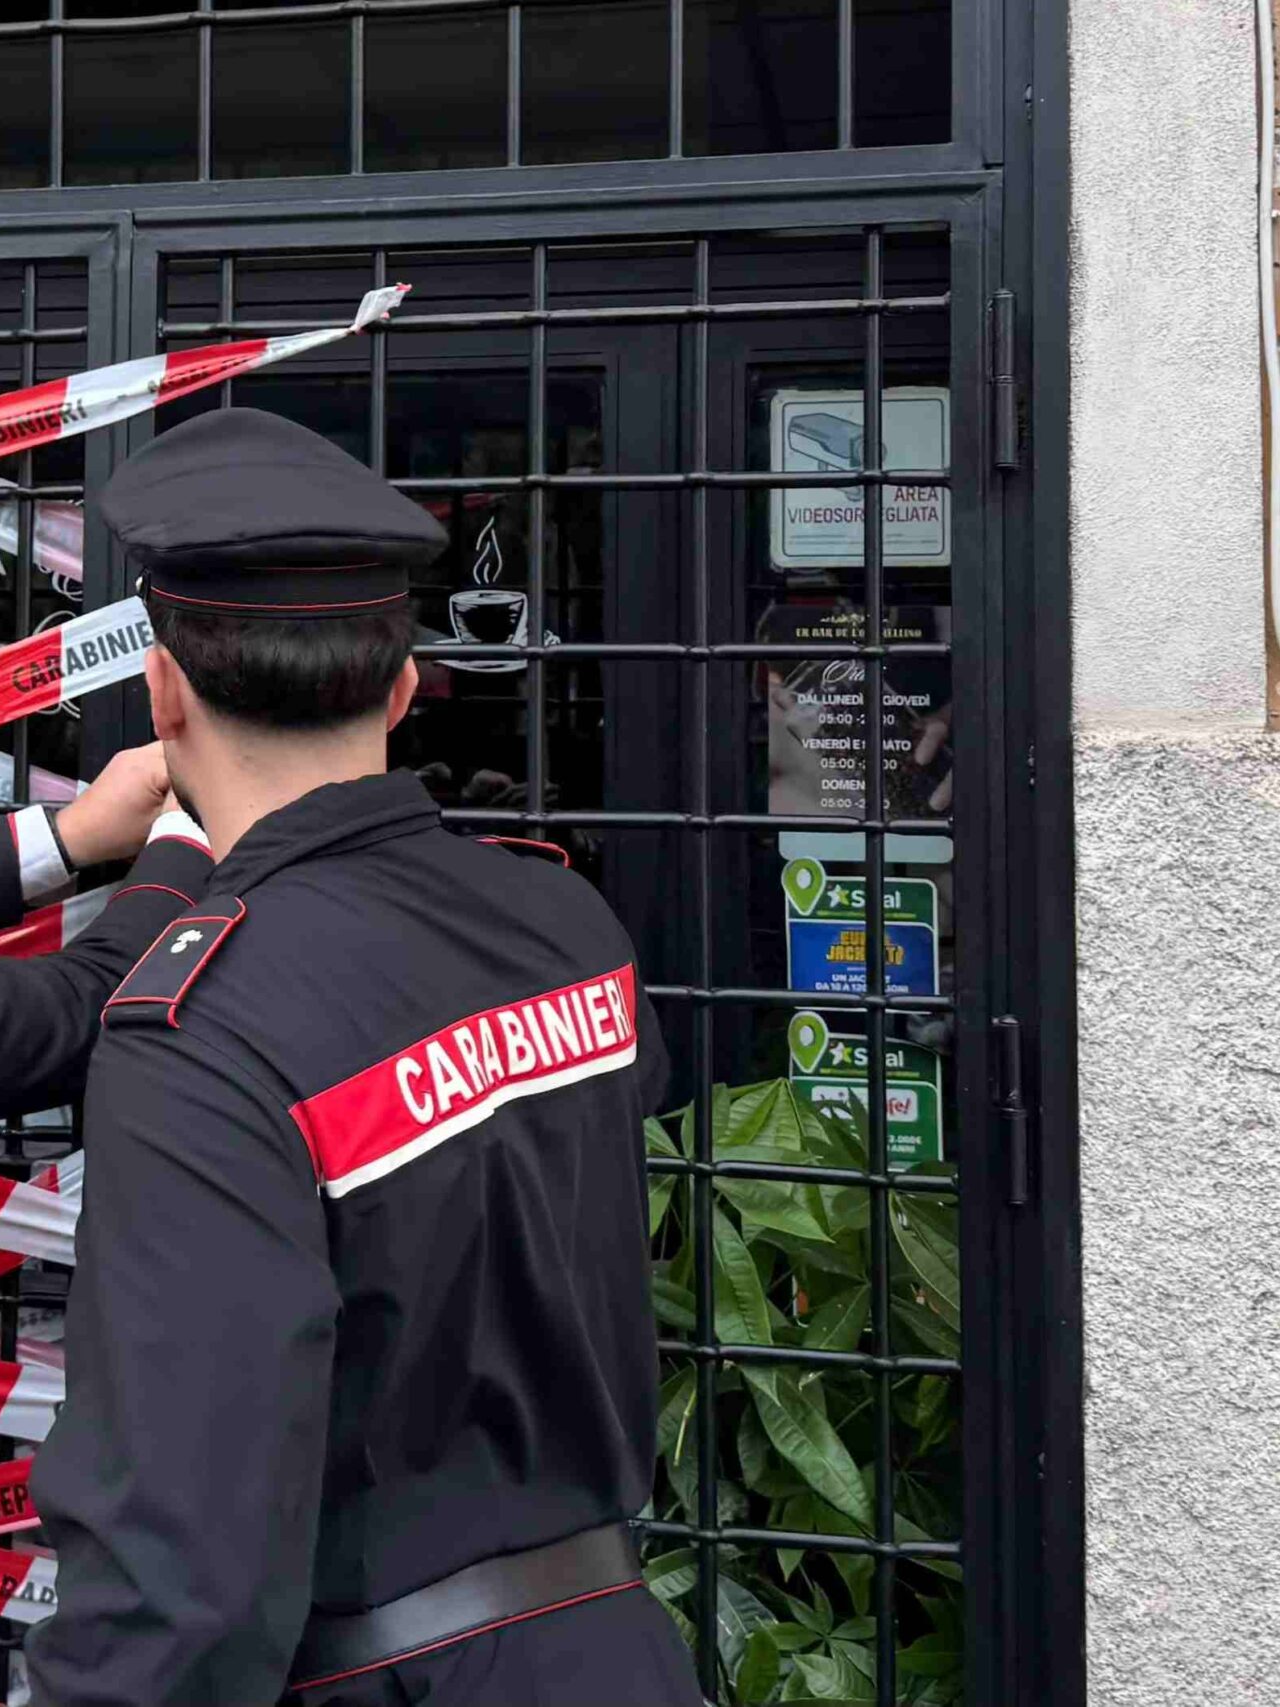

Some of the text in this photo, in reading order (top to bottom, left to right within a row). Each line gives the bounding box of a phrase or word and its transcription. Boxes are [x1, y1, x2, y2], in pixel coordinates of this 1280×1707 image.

[894, 487, 940, 502] AREA
[788, 506, 940, 524] VIDEOSORGLIATA
[812, 628, 833, 637] BAR
[12, 621, 155, 693] CARABINIE
[797, 691, 931, 706] DAL LUNEDÌ GIOVEDÌ
[818, 713, 853, 724] 05:00
[802, 737, 851, 749] VENERDÌ
[853, 738, 861, 749] E
[820, 758, 855, 769] 05:00
[822, 779, 866, 790] DOMEN
[820, 798, 853, 808] 05:00
[851, 889, 902, 909] Sal
[848, 974, 891, 984] JACT
[396, 975, 633, 1125] CARABINIERI
[854, 1047, 904, 1068] Sal
